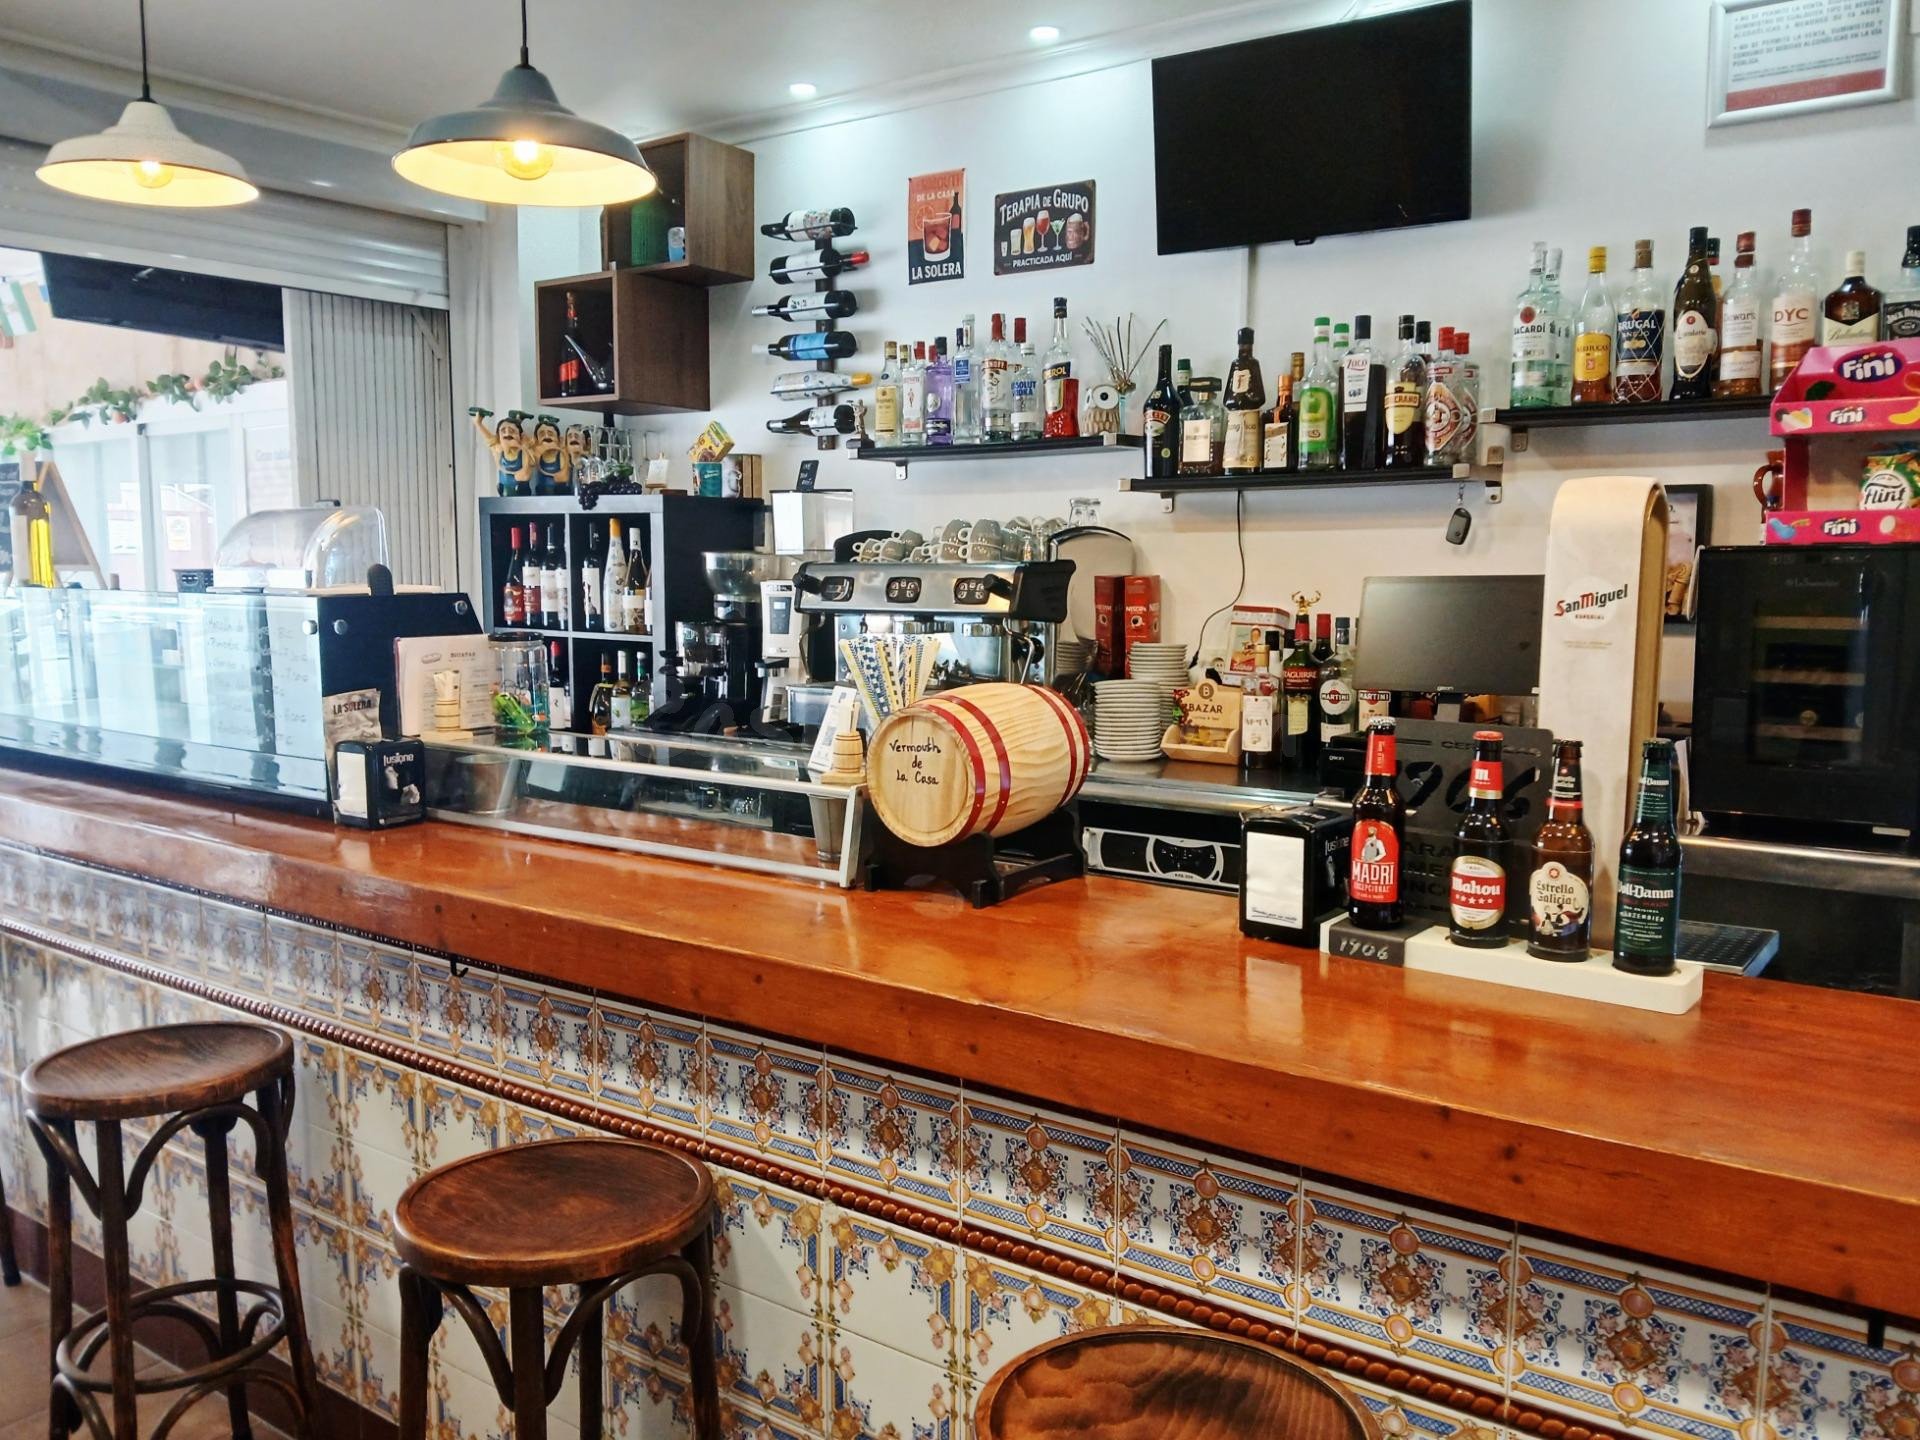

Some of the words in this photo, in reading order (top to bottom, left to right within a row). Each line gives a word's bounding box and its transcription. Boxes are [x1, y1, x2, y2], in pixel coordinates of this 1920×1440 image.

[916, 194, 924, 202] DE
[926, 192, 935, 200] LA
[1000, 194, 1040, 226] TERAPIA
[1042, 196, 1052, 208] DE
[1053, 188, 1089, 212] GRUPO
[1012, 255, 1054, 268] PRACTICADA
[1055, 252, 1073, 263] AQUÍ
[912, 266, 924, 280] LA
[925, 261, 962, 278] SOLERA
[1774, 308, 1808, 323] DYC
[1514, 322, 1546, 336] BACARDÍ
[1618, 319, 1656, 330] BRUGAL
[1842, 351, 1895, 381] Fini
[1830, 406, 1864, 424] Fini
[1824, 518, 1857, 536] Fini
[1321, 693, 1350, 702] MARTINI
[1360, 692, 1390, 700] MARTINI
[333, 704, 342, 714] LA
[344, 700, 372, 712] SOLERA
[1189, 704, 1223, 714] BAZAR
[889, 737, 937, 753] Vermouth
[912, 754, 923, 768] de
[896, 769, 908, 782] La
[915, 771, 940, 784] Casa
[1452, 878, 1500, 896] Mahou
[1536, 880, 1574, 894] Estrella
[1538, 892, 1572, 905] Galicia
[1338, 938, 1390, 960] 1906
